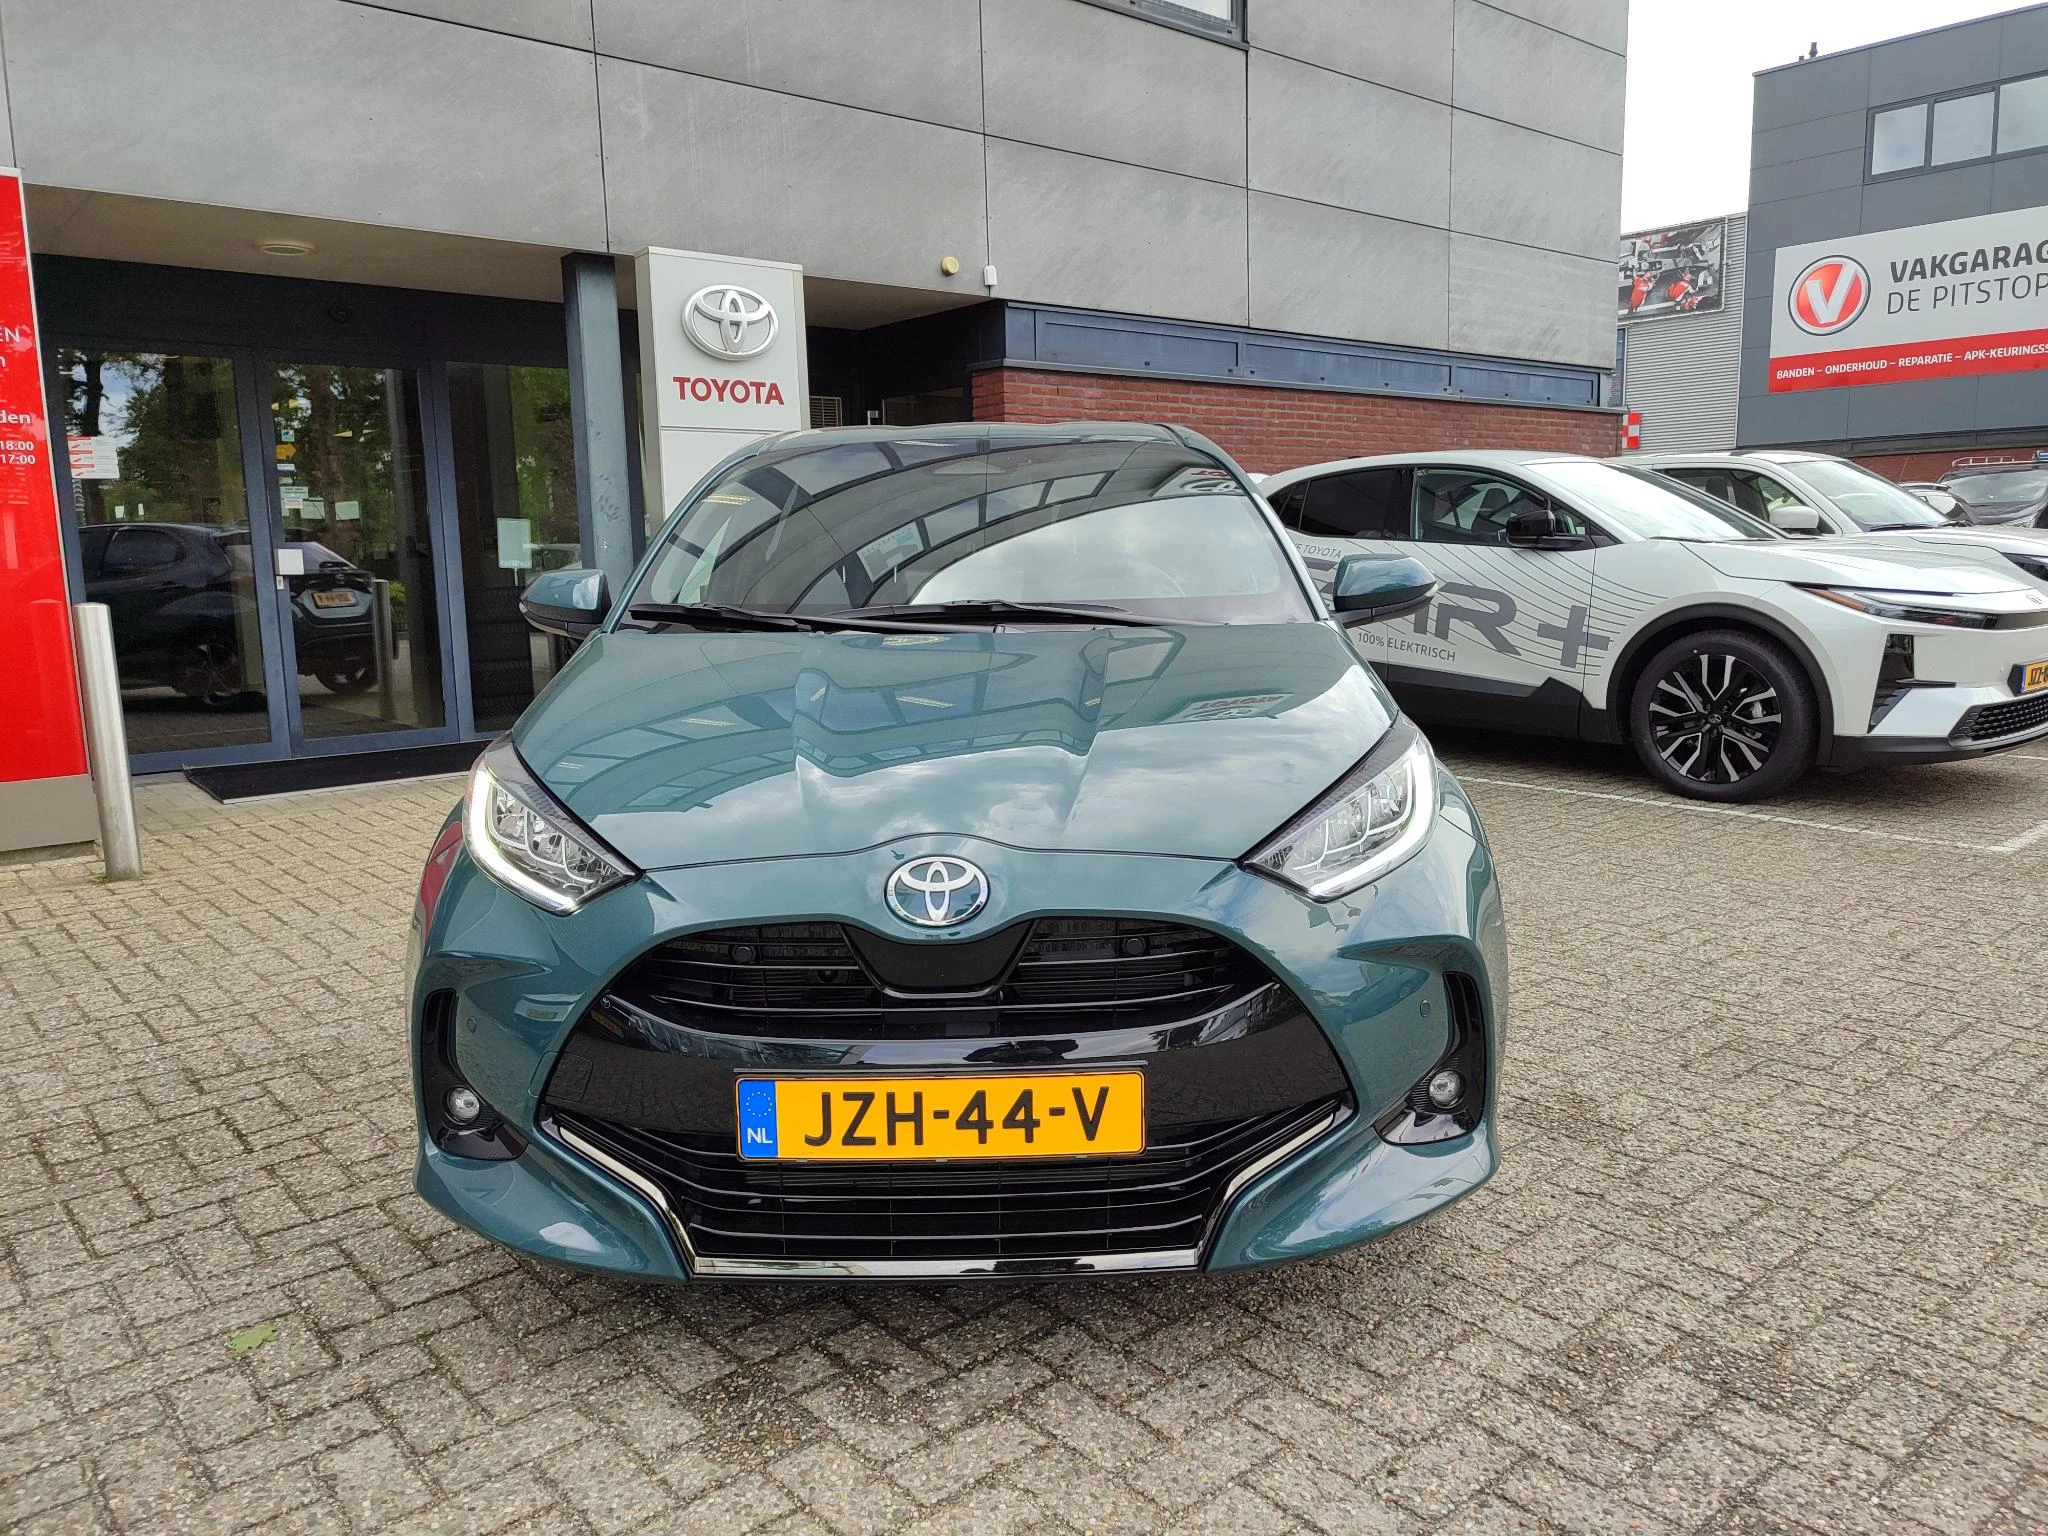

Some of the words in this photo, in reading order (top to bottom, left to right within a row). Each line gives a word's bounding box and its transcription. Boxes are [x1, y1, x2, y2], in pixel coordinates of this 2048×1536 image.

[1887, 288, 1921, 315] DE
[1932, 272, 2048, 310] PITSTOP
[0, 328, 20, 343] N
[1776, 367, 1815, 380] BANDEN
[1825, 359, 1888, 375] ONDERHOUD
[1898, 353, 1953, 368] REPARATIE
[673, 376, 784, 406] TOYOTA
[1304, 544, 1342, 560] TOYOTA
[1357, 632, 1385, 647] 100%
[1387, 637, 1456, 662] ELEKTRISCH
[804, 1085, 1110, 1147] JZH-44-V
[746, 1127, 774, 1144] NL
